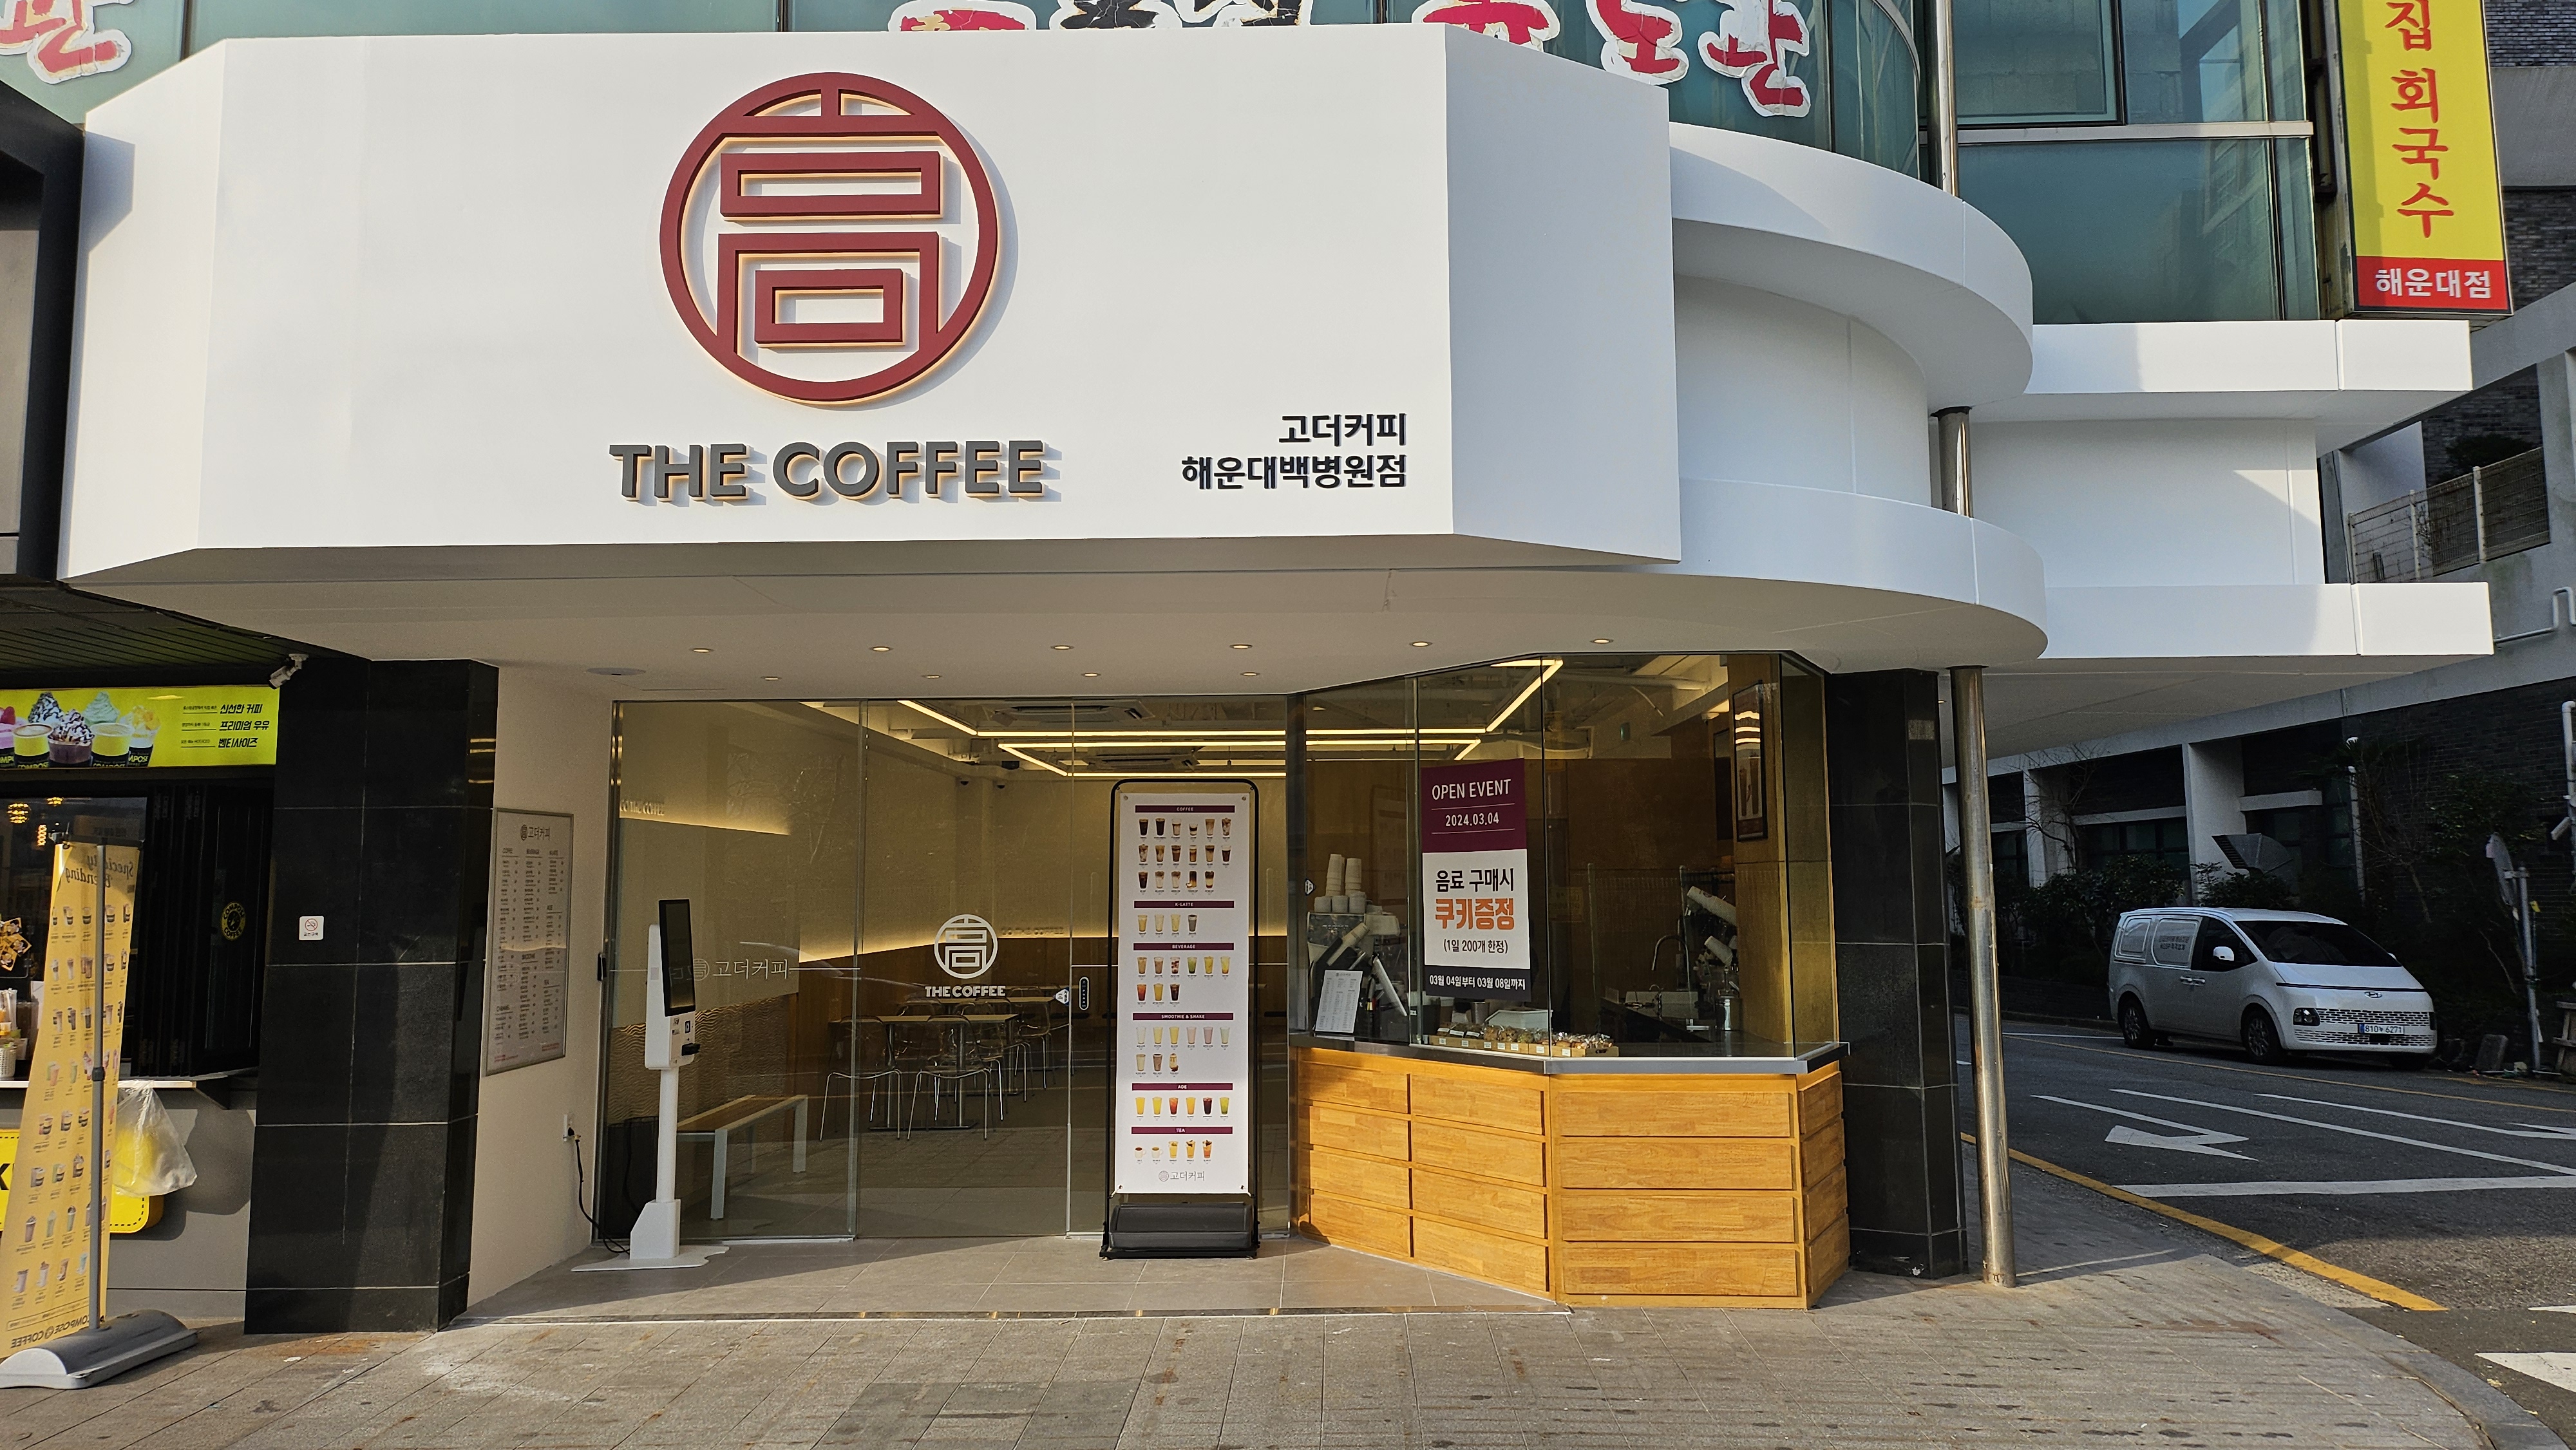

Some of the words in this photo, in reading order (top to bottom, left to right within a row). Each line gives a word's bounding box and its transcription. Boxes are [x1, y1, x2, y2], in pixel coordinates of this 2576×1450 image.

[2390, 67, 2454, 239] 회국수
[2374, 268, 2491, 299] 해운대점
[1278, 413, 1407, 447] 고더커피
[609, 443, 749, 500] THE
[772, 440, 1045, 500] COFFEE
[1181, 454, 1407, 490] 해운대백병원점
[220, 704, 245, 715] 신선한
[246, 704, 263, 714] 커피
[219, 720, 252, 731] 프리미엄
[252, 720, 270, 731] 우유
[218, 737, 259, 748] 벤티사이즈
[1432, 782, 1466, 801] OPEN
[1469, 778, 1511, 798] EVENT
[1444, 811, 1500, 827] 2024.03.04
[1435, 869, 1465, 893] 음료
[1468, 867, 1515, 892] 구매시
[1435, 898, 1515, 930] 쿠키증정
[1443, 939, 1460, 952] (1일
[1461, 939, 1486, 954] 200개
[1488, 939, 1508, 954] 한정)
[712, 958, 789, 980] 고더커피
[925, 986, 951, 997] THE
[952, 985, 1007, 997] COFFEE
[1429, 974, 1445, 987] 03월
[1446, 975, 1475, 988] 04일부터
[1477, 976, 1493, 989] 03월
[1495, 977, 1526, 991] 08일까지
[1170, 1171, 1206, 1182] 고더커피
